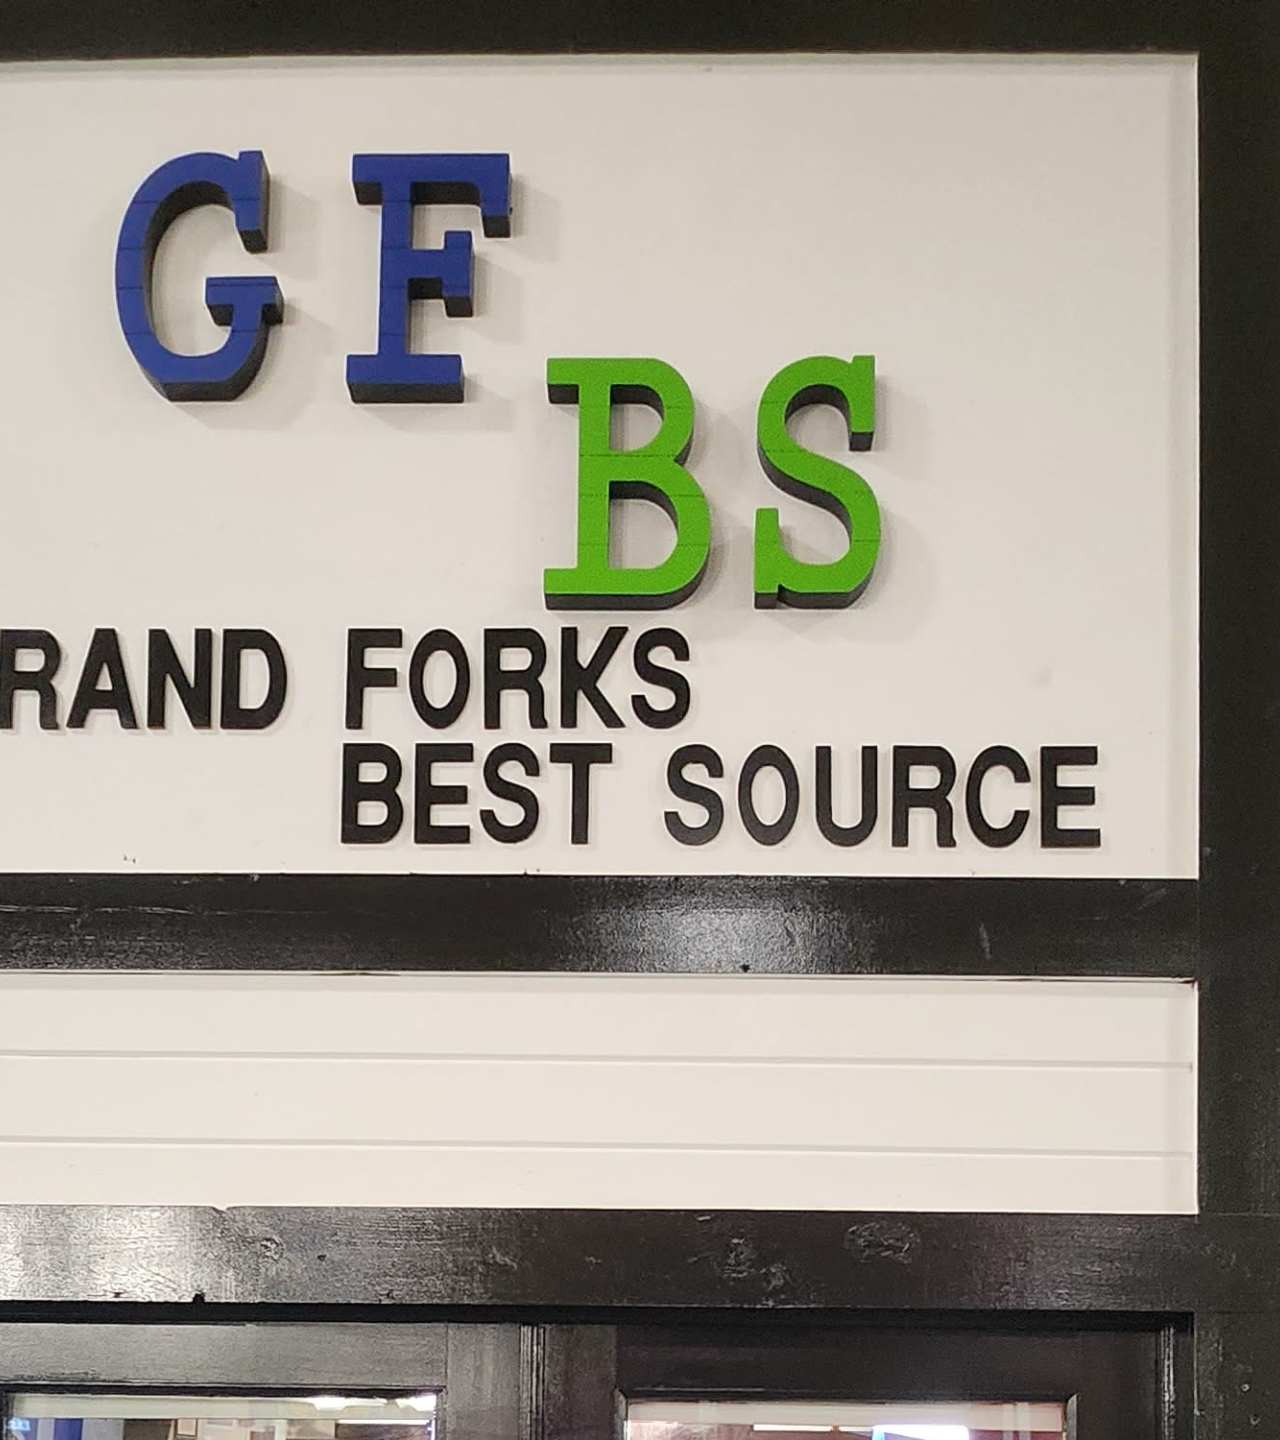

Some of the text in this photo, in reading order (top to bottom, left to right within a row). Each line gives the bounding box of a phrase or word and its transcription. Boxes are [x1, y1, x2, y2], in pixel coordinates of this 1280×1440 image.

[114, 149, 513, 404] GF
[542, 355, 884, 610] BS
[343, 625, 693, 731] FORKS
[338, 742, 1103, 849] BEST SOURCE
